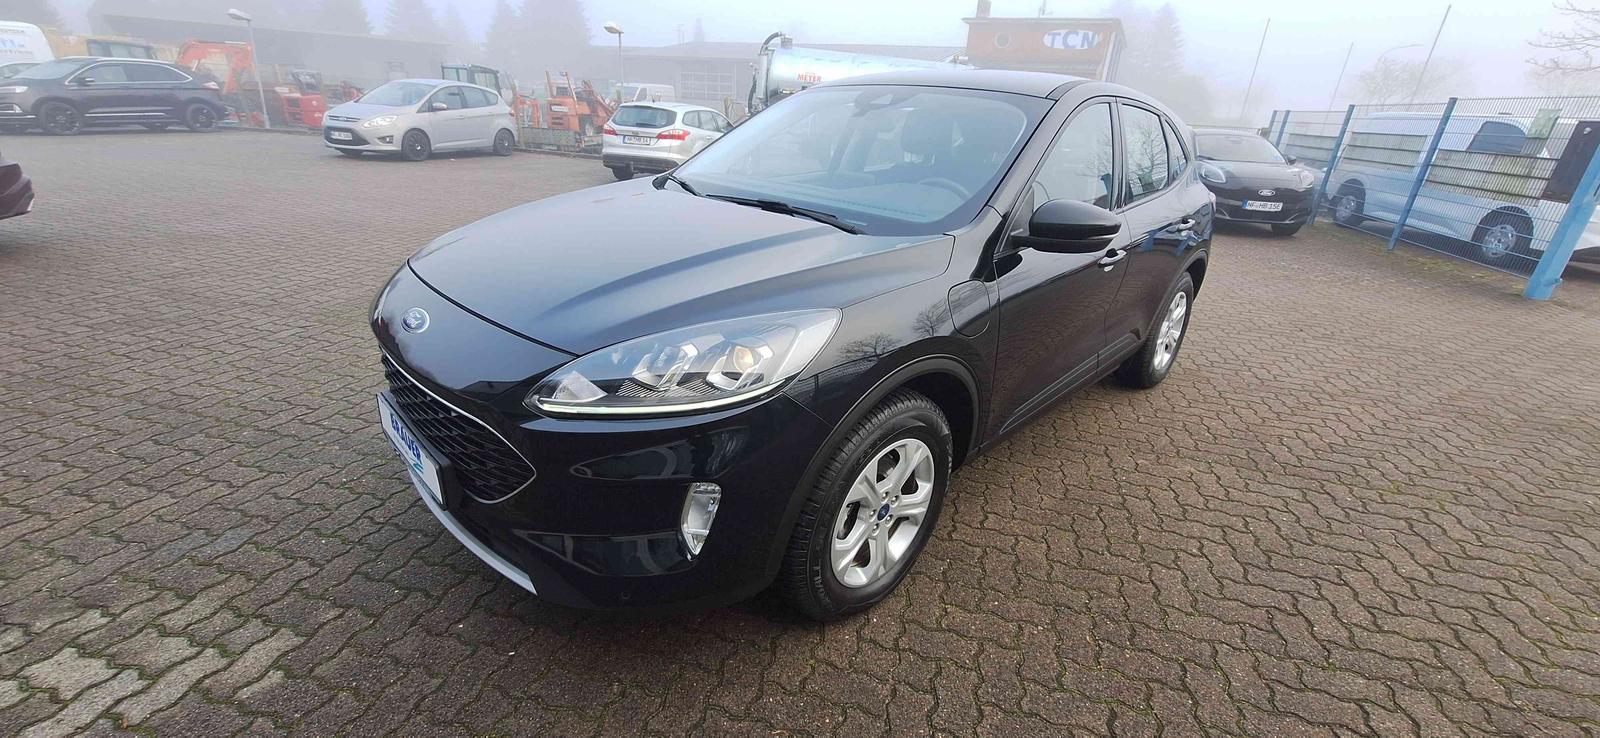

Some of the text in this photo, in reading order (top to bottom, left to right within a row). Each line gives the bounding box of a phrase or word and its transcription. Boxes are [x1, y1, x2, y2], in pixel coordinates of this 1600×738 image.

[1048, 31, 1097, 48] TCN
[798, 74, 822, 82] MEYER
[390, 413, 423, 464] BRAUER
